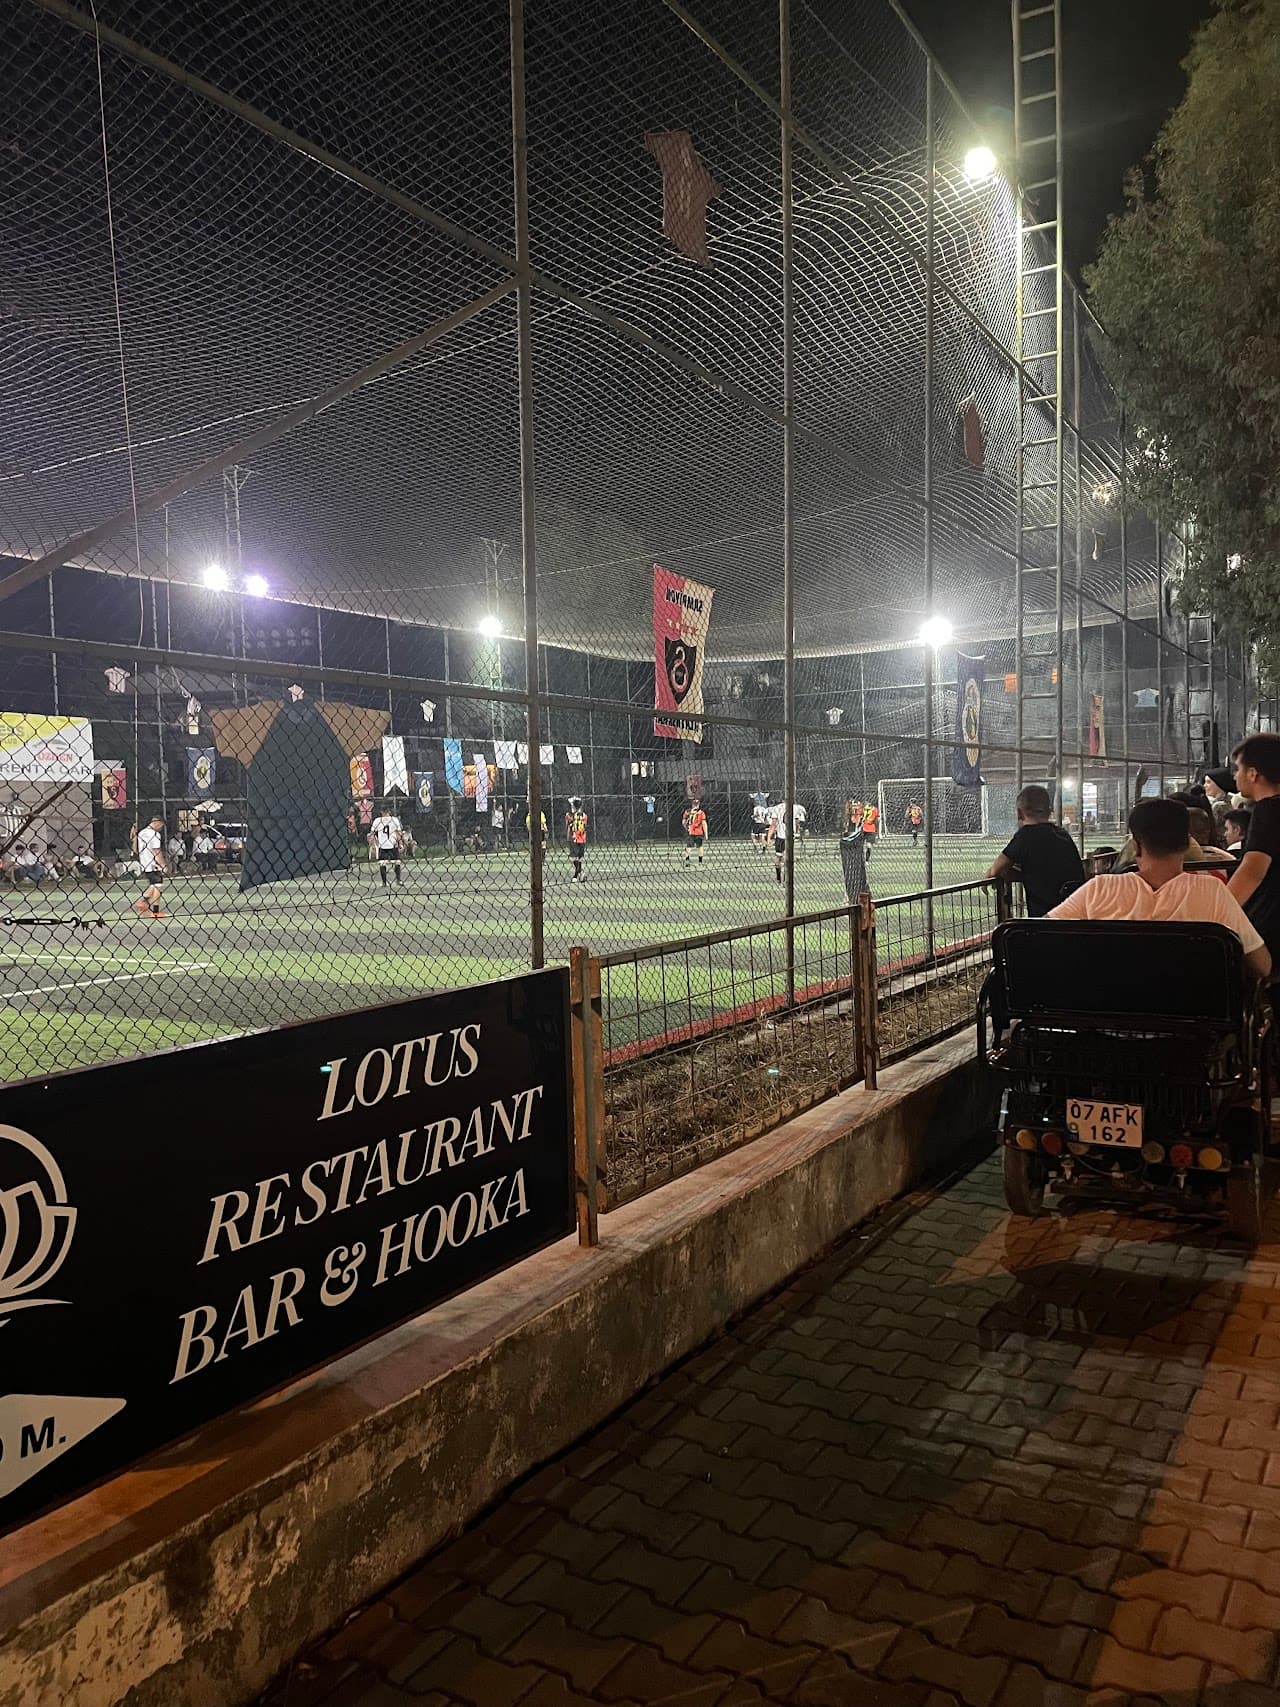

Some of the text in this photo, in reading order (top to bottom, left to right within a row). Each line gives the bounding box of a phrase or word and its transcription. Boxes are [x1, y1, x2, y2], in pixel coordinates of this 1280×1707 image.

[0, 764, 39, 774] RENT
[59, 767, 91, 775] CAR
[317, 1023, 481, 1121] LOTUS
[1071, 1103, 1138, 1126] 07 AFK
[1091, 1125, 1126, 1143] 162
[197, 1085, 543, 1265] RESTAURANT
[169, 1168, 531, 1385] BAR & HOOKA
[20, 1416, 66, 1459] M.
